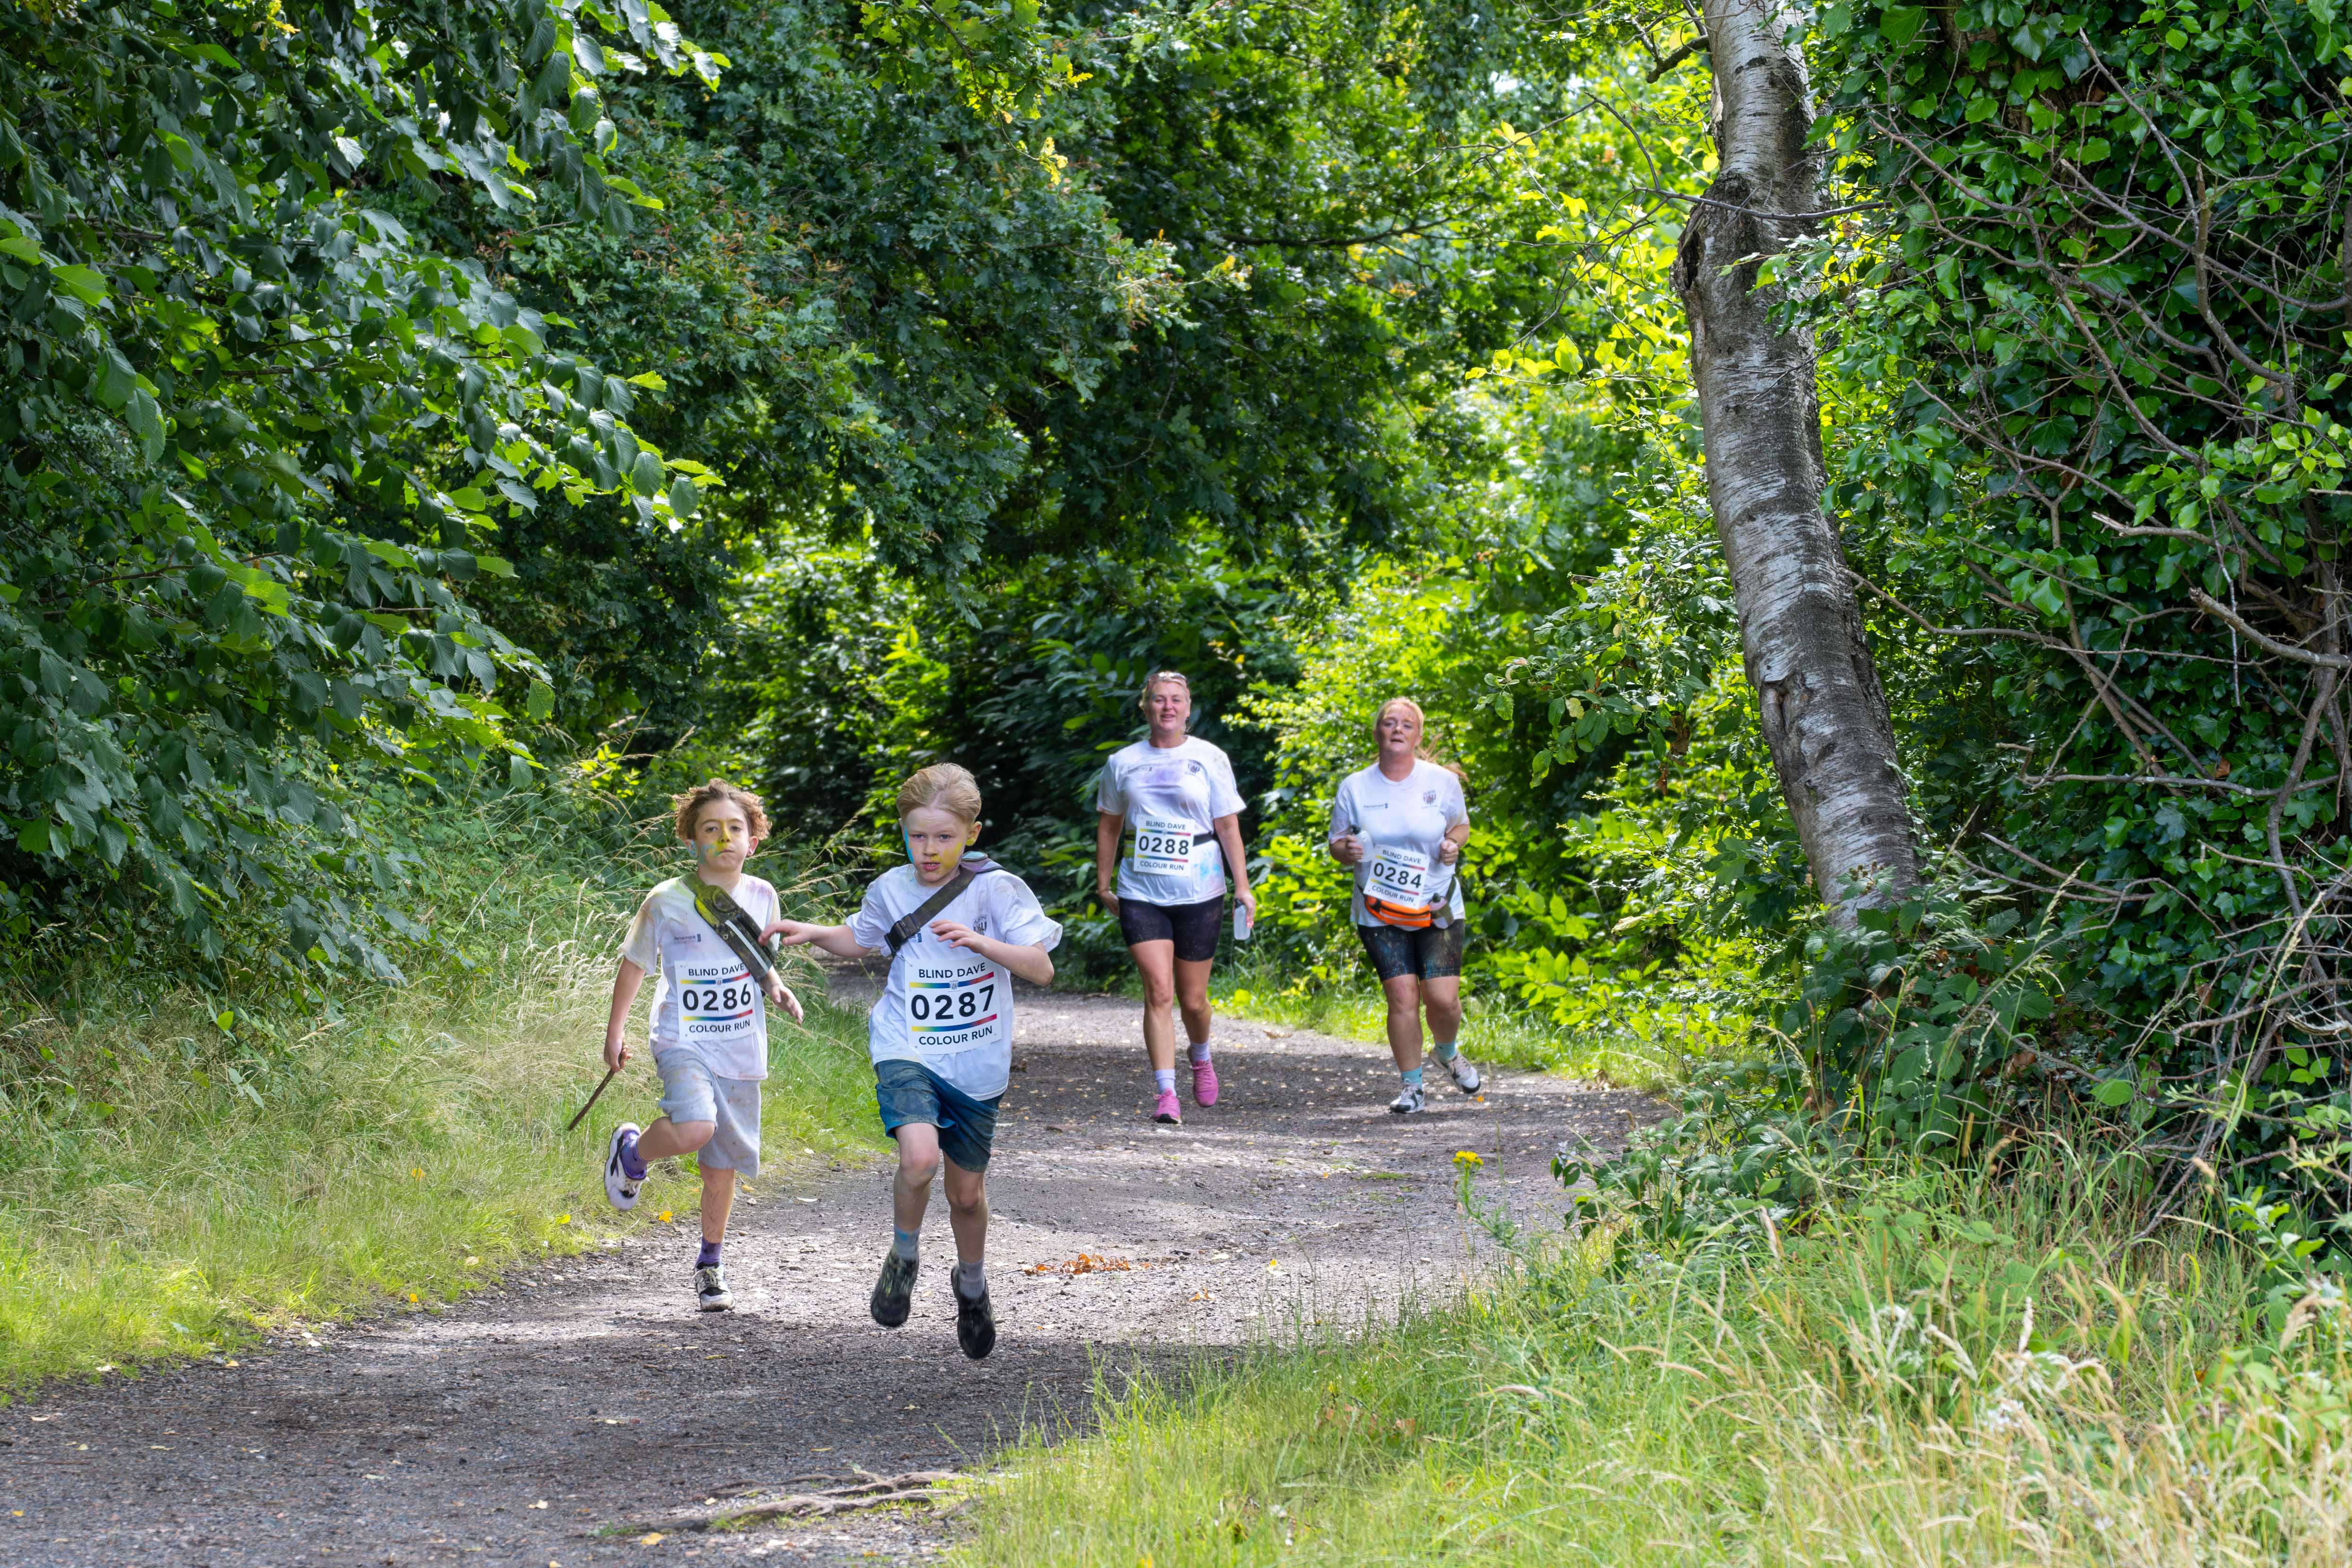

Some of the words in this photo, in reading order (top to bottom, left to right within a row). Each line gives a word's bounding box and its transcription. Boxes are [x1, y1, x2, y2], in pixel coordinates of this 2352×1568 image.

[1139, 835, 1189, 855] 0288
[1140, 861, 1167, 869] COLOUR
[1383, 850, 1402, 860] BLIND
[1404, 855, 1421, 864] DAVE
[1374, 862, 1422, 888] 0284
[1372, 885, 1398, 898] COLOUR
[1399, 893, 1415, 903] RUN
[688, 968, 718, 976] BLIND
[722, 963, 744, 974] DAVE
[919, 969, 953, 978] BLIND
[957, 962, 986, 977] DAVE
[683, 983, 751, 1011] 0286
[911, 984, 994, 1020] 0287
[689, 1024, 731, 1033] COLOUR
[734, 1019, 750, 1030] RUN
[919, 1034, 968, 1045] COLOUR
[972, 1026, 993, 1040] RUN
